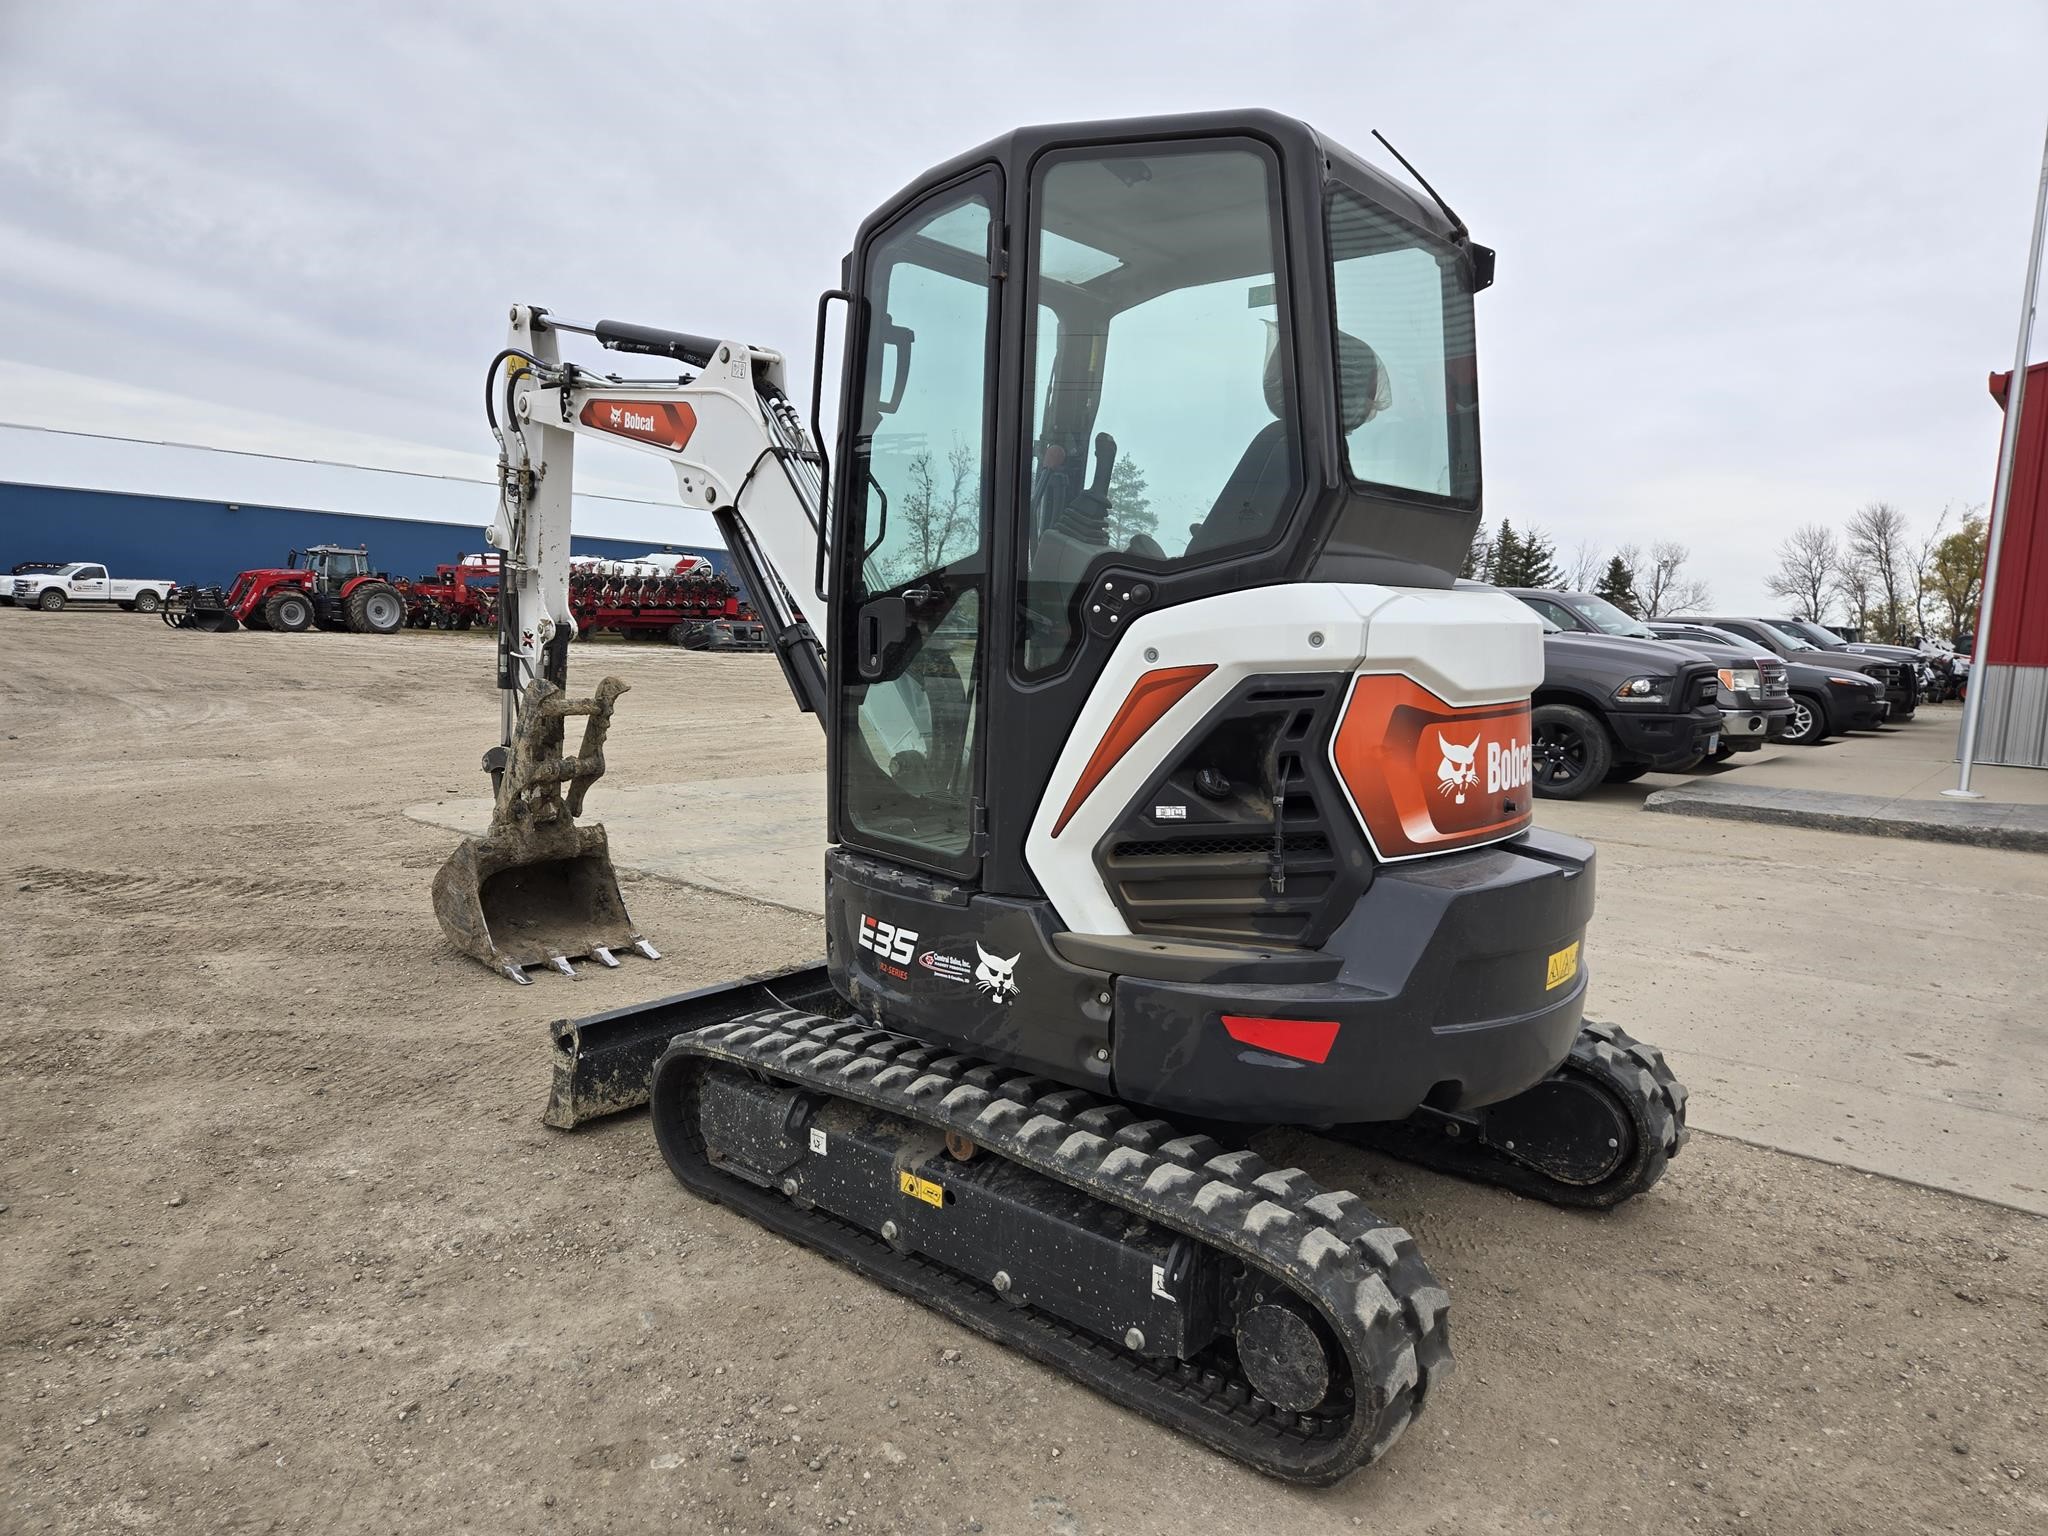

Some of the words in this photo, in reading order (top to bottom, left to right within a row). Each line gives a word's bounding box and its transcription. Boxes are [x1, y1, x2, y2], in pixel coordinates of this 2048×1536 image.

[624, 412, 655, 432] Bobcat
[1487, 738, 1533, 794] Bobca
[859, 913, 919, 966] E35
